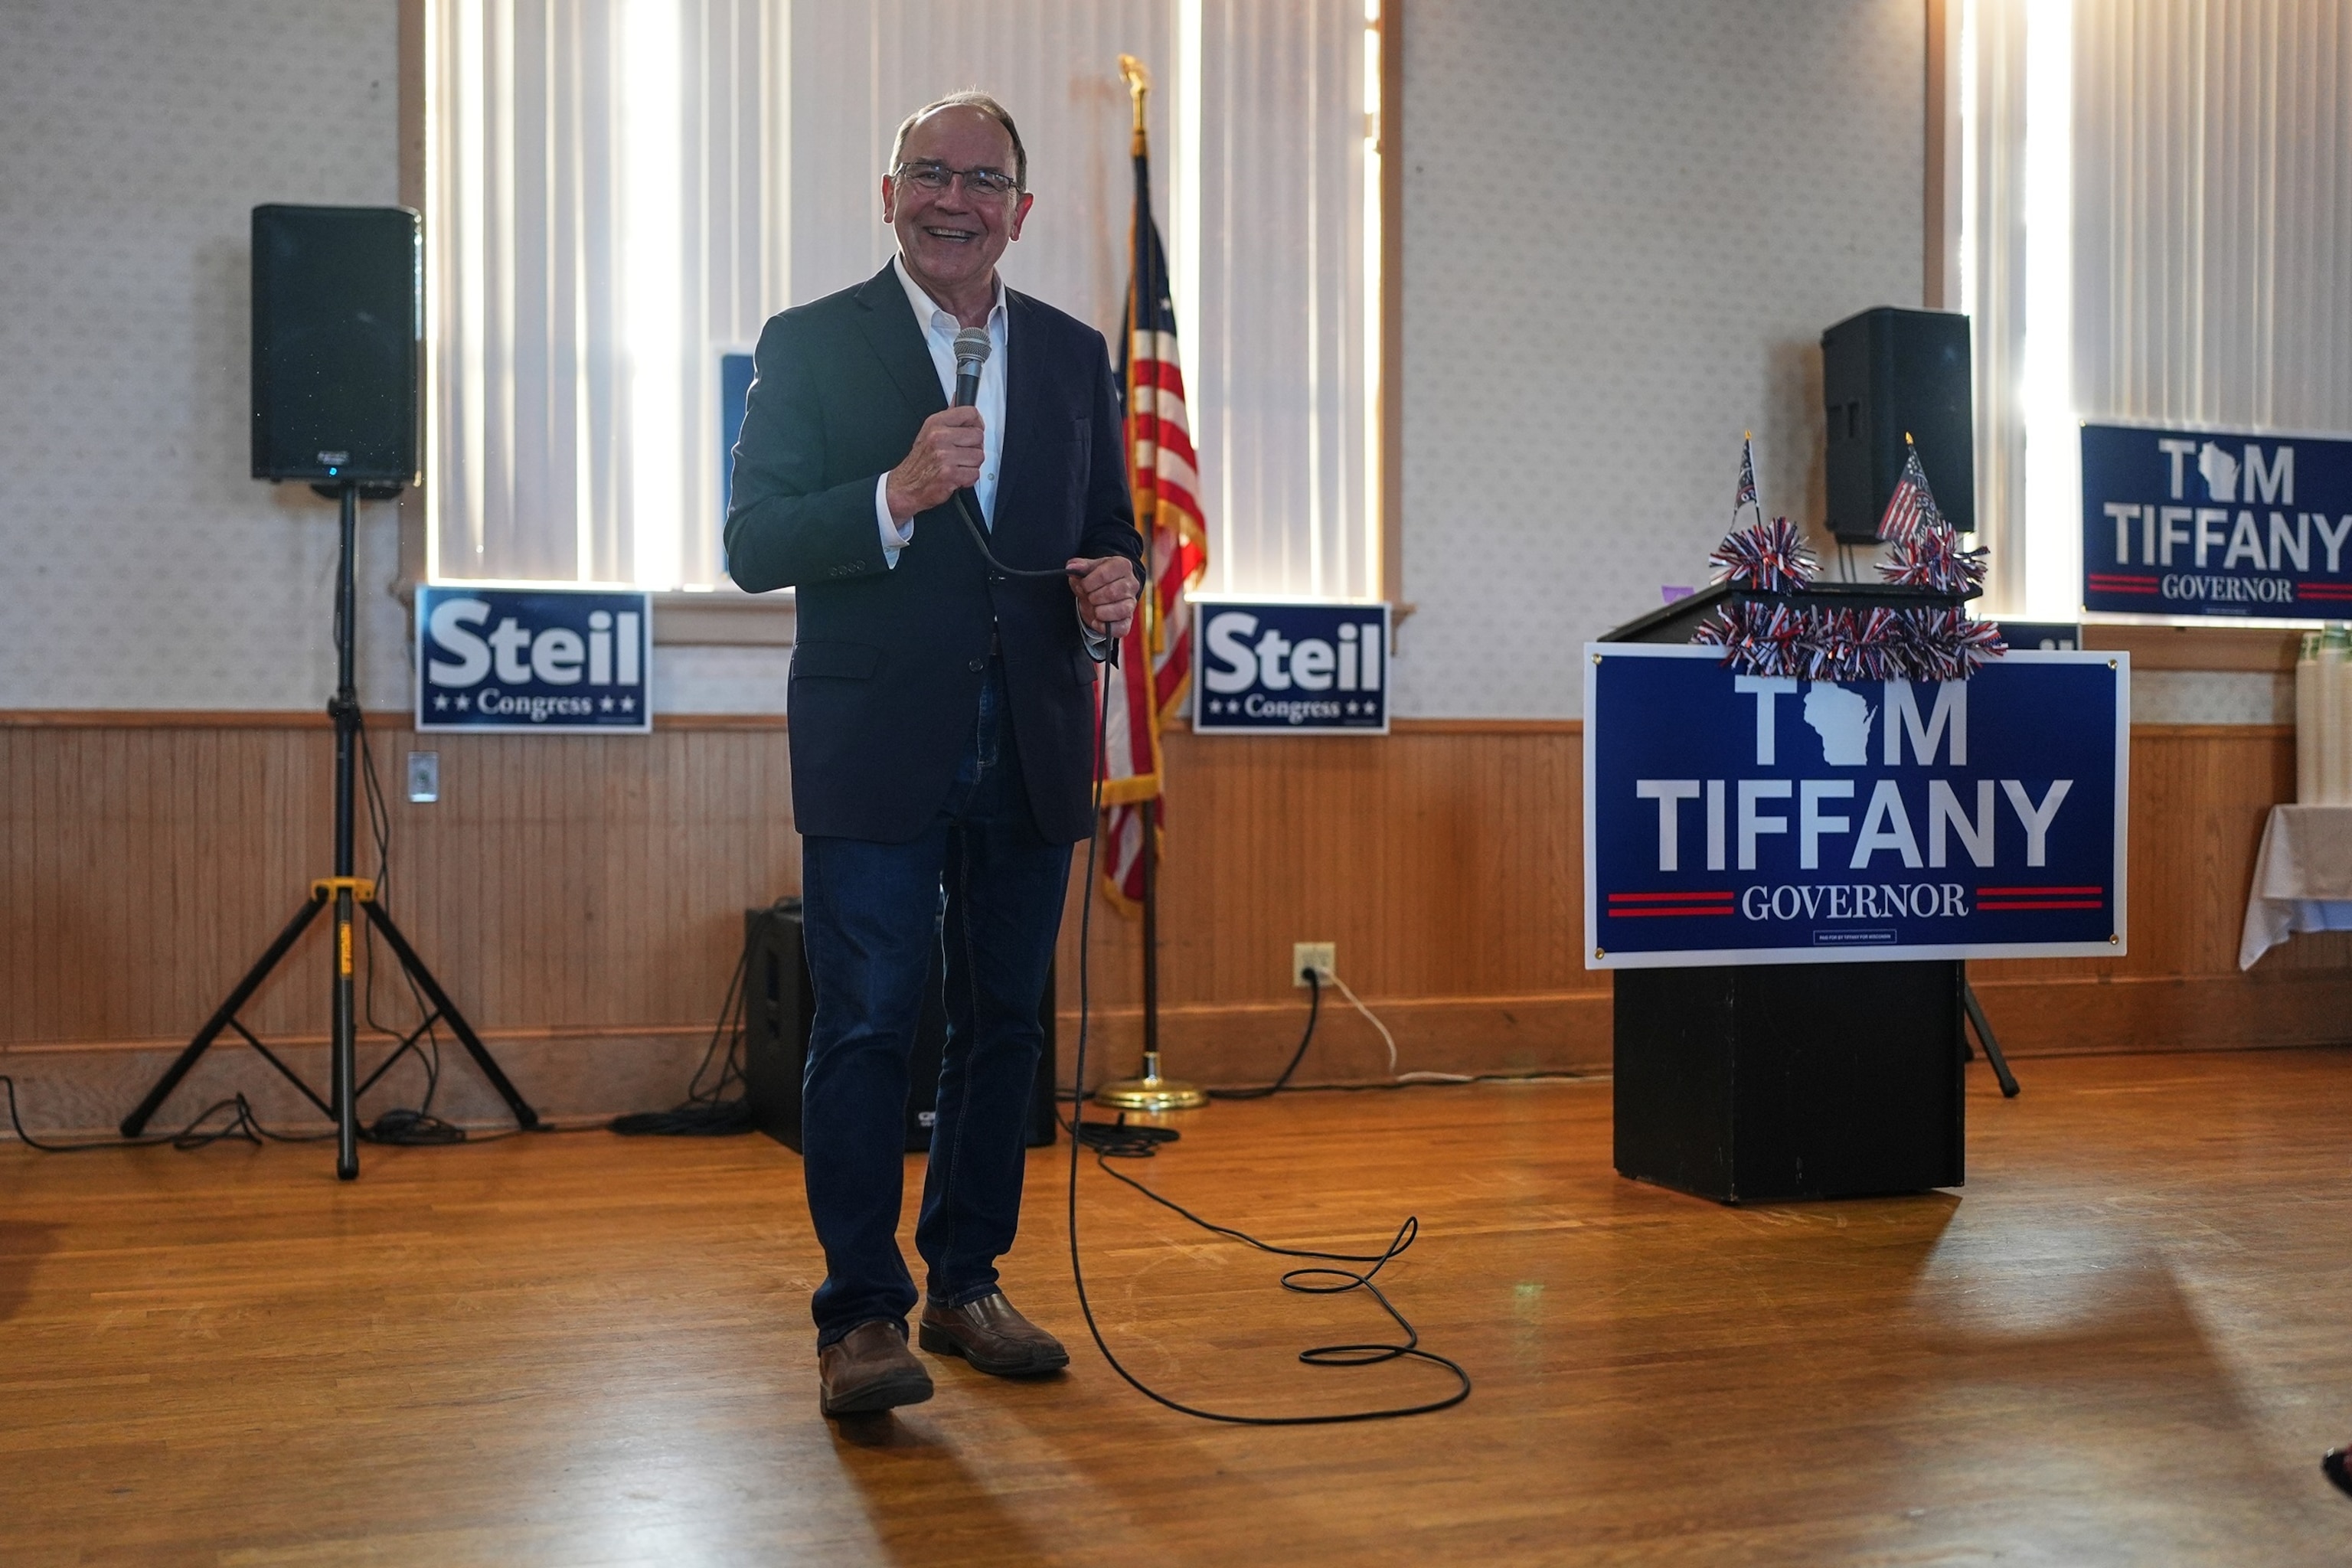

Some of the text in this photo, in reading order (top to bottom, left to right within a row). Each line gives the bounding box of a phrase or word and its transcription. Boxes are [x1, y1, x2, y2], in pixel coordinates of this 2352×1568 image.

[2103, 502, 2352, 573] TIFFANY
[2161, 573, 2294, 603] GOVERNOR
[428, 597, 640, 688] Steil
[1205, 612, 1381, 694] Steil
[477, 688, 593, 723] Congress
[1244, 693, 1341, 724] Congress
[1636, 779, 2074, 871] TIFFANY
[1742, 883, 1969, 920] GOVERNOR
